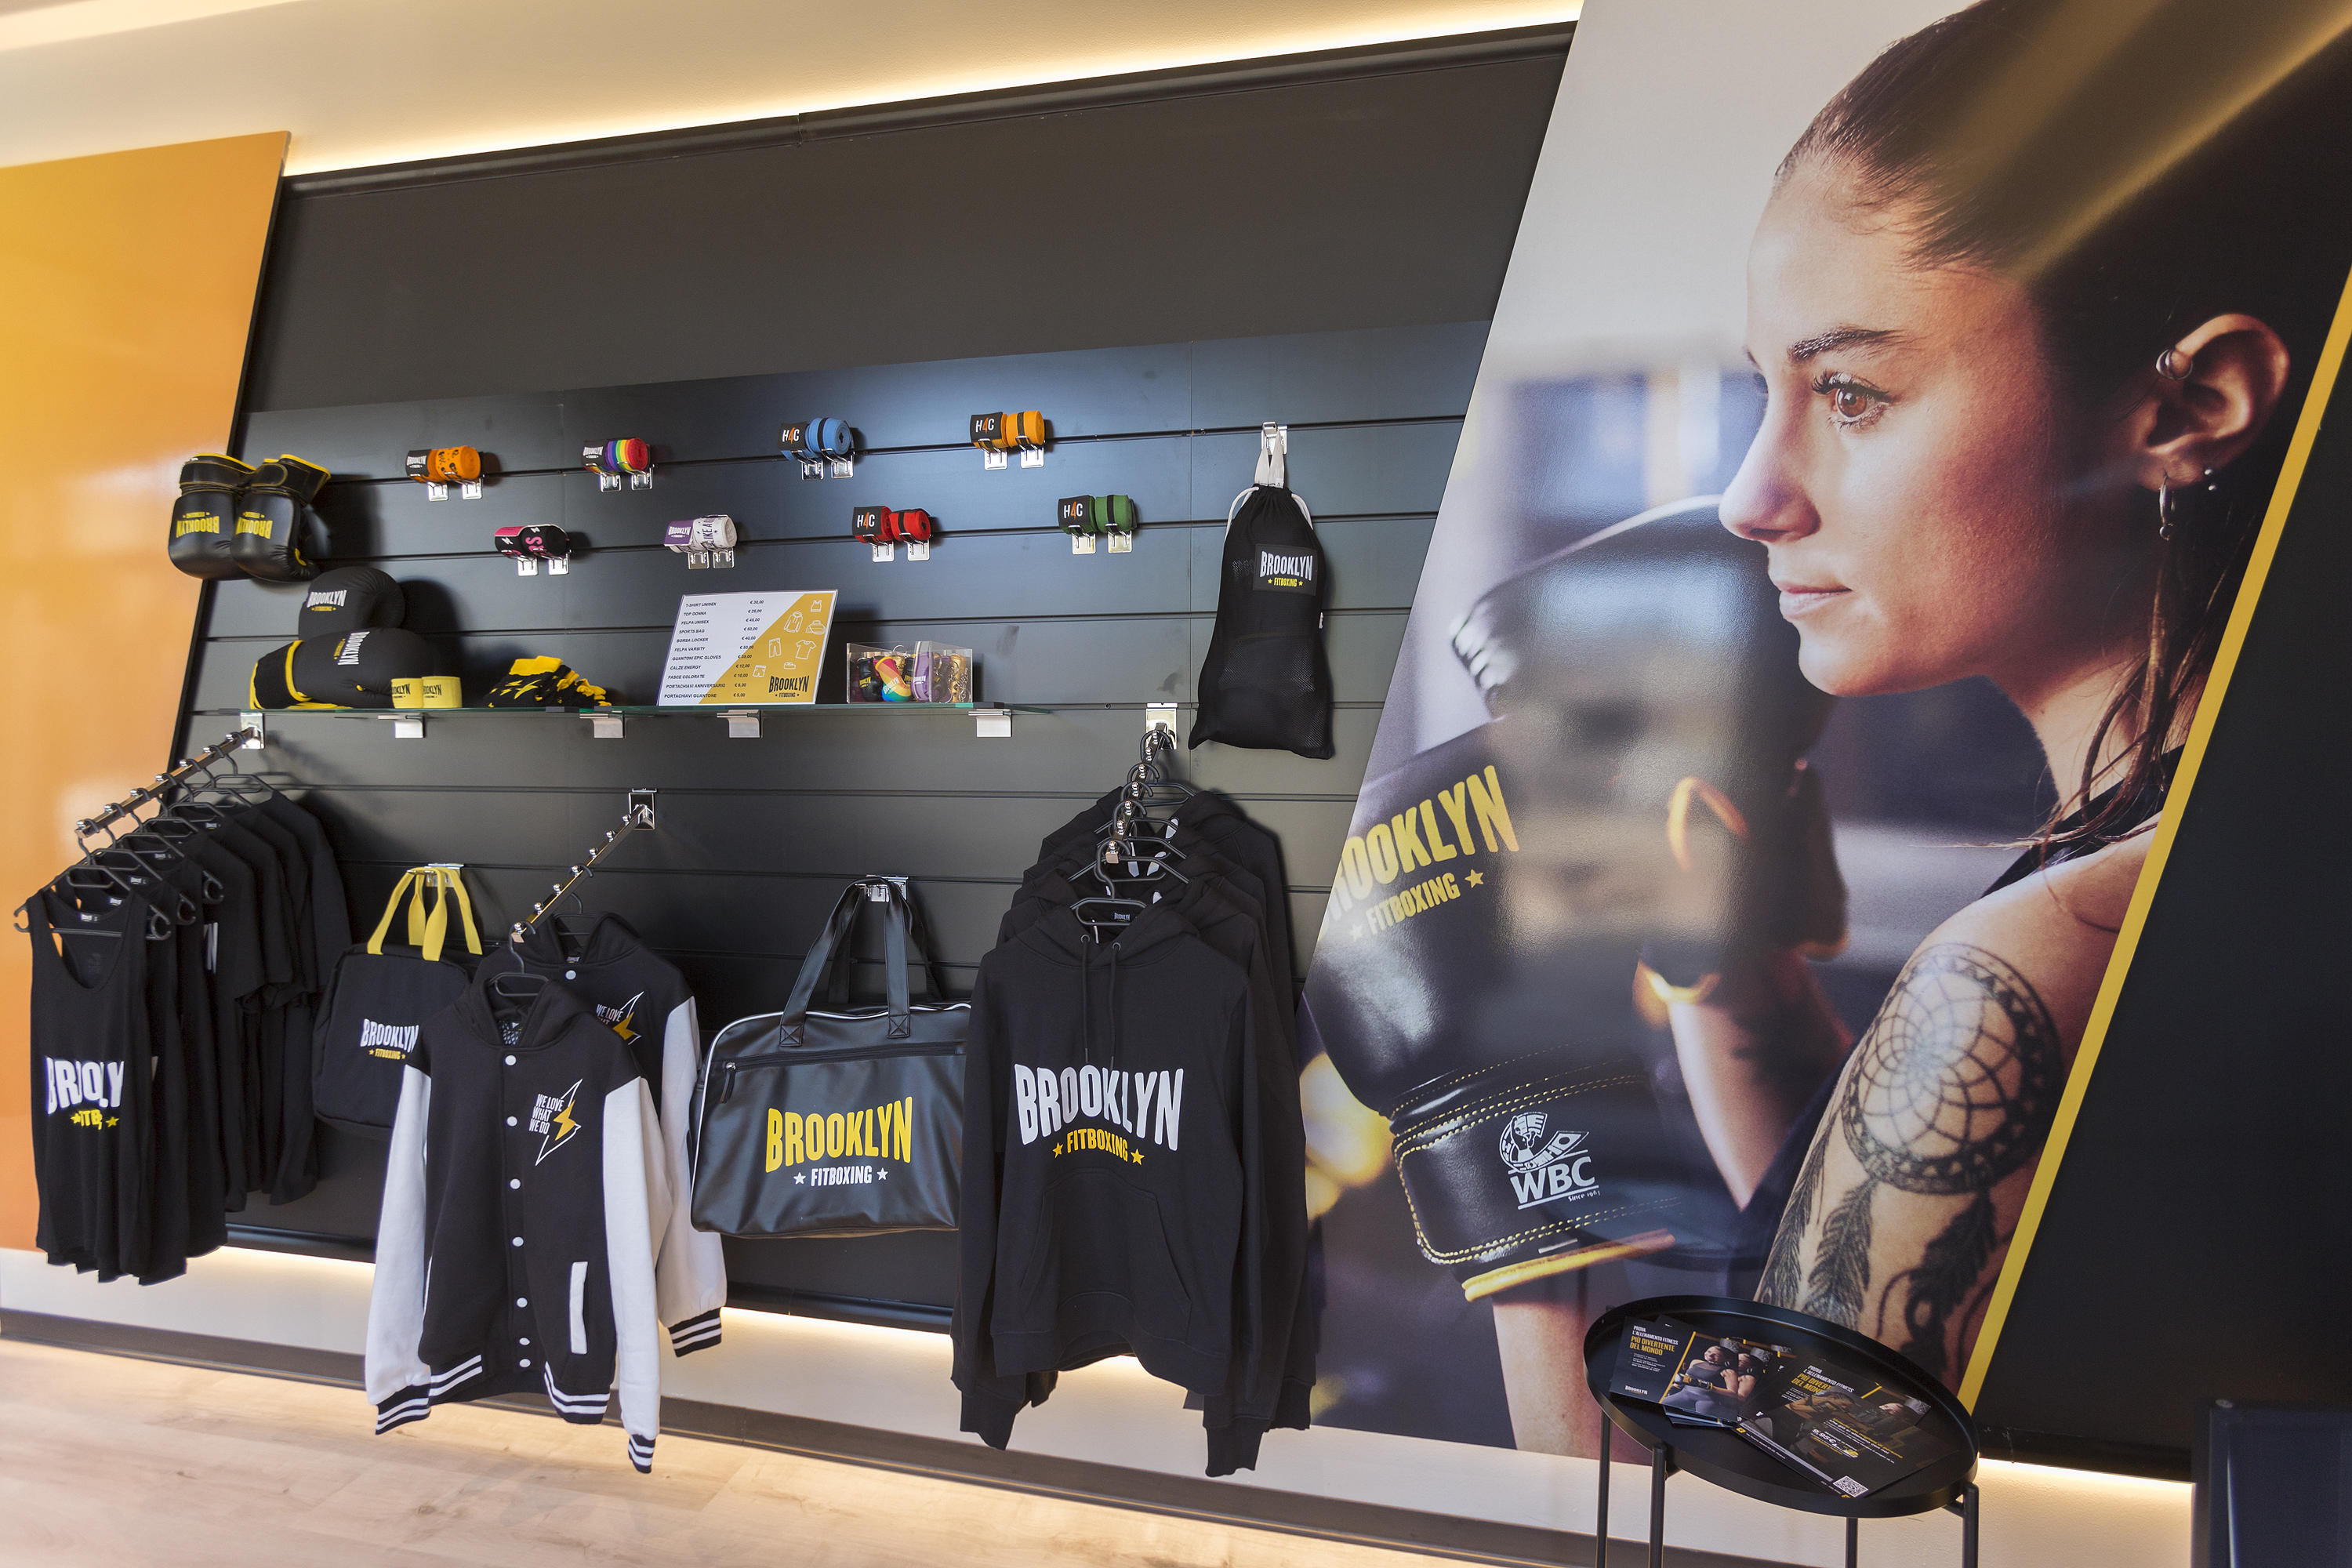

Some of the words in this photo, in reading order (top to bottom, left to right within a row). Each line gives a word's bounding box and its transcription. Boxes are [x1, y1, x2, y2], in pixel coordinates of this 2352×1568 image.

[975, 417, 994, 434] H4C
[782, 426, 800, 444] H4C
[1063, 502, 1083, 520] H4C
[176, 516, 220, 538] BROOKLYN
[857, 512, 875, 530] H4C
[1259, 550, 1313, 581] BROOKLYN
[1274, 577, 1297, 586] FITBOXING
[307, 590, 347, 608] BROOKLYN
[337, 631, 370, 665] BROOKLYN
[768, 676, 810, 693] BROOKLYN
[1366, 873, 1461, 935] FITBOXING
[596, 1004, 608, 1018] WE
[605, 1007, 623, 1022] LOVE
[360, 1018, 419, 1053] BROOKLYN
[535, 1094, 548, 1109] WE
[546, 1097, 564, 1112] LOVE
[1014, 1063, 1184, 1152] BROOKLYN
[532, 1106, 553, 1122] WHAT
[528, 1118, 540, 1132] WE
[539, 1120, 550, 1134] DO
[765, 1096, 913, 1173] BROOKLYN
[1066, 1128, 1128, 1162] FITBOXING
[811, 1165, 873, 1187] FITBOXING
[1510, 1156, 1595, 1203] WBC
[1568, 1193, 1585, 1202] Since
[1632, 1330, 1662, 1341] L'ALLENAMENTO
[1662, 1336, 1679, 1345] FITNESS
[1642, 1338, 1675, 1352] DIVERTENTE
[1642, 1345, 1663, 1356] MONDO
[1791, 1377, 1804, 1387] DEL
[1797, 1373, 1810, 1381] PIÙ
[1624, 1385, 1648, 1395] BROOKLYN
[1835, 1382, 1854, 1392] FITNESS
